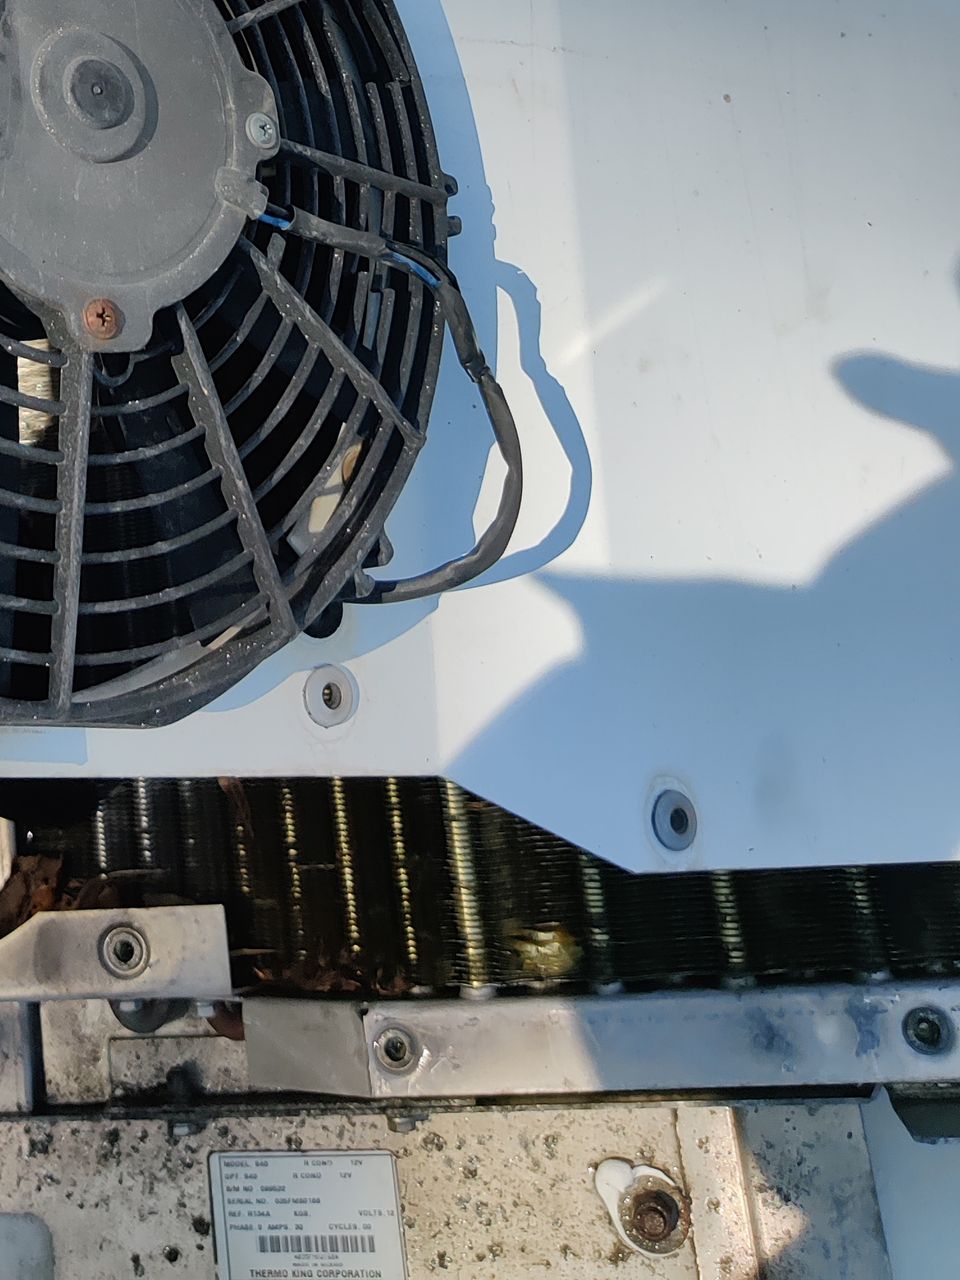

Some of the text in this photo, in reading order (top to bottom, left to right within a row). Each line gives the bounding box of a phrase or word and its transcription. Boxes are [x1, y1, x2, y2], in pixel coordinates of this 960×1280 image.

[250, 1269, 382, 1278] THERMO KING CORPORATION
